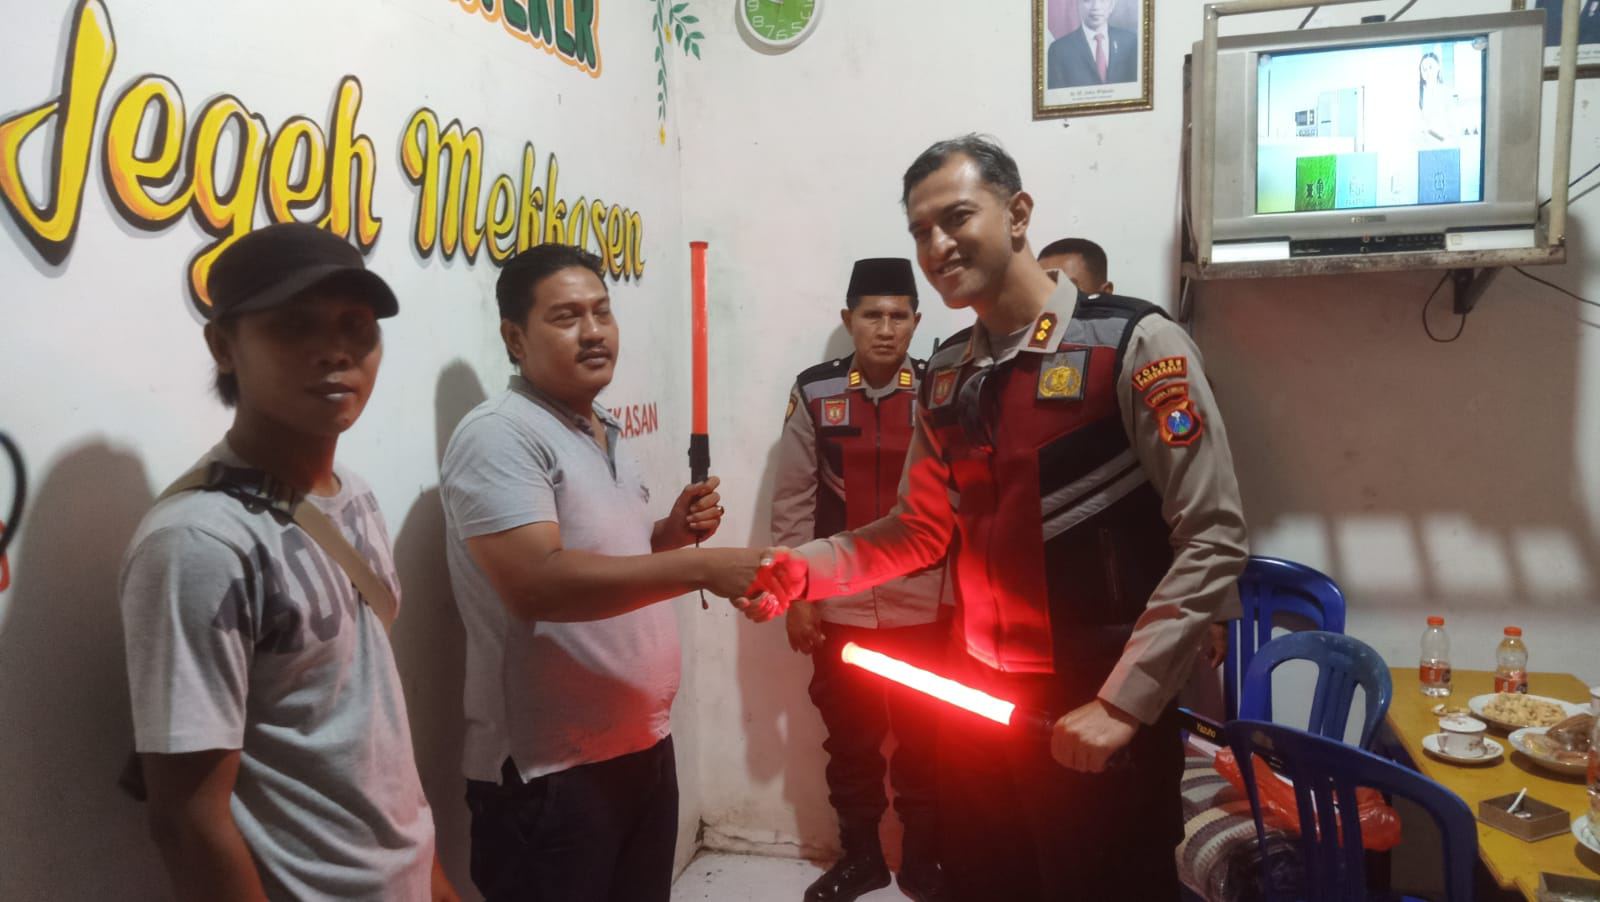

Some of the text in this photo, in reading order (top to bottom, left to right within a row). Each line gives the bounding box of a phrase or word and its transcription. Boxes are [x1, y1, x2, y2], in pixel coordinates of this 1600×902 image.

[752, 15, 764, 28] 8
[765, 24, 776, 38] 7
[0, 0, 382, 317] Jegeh
